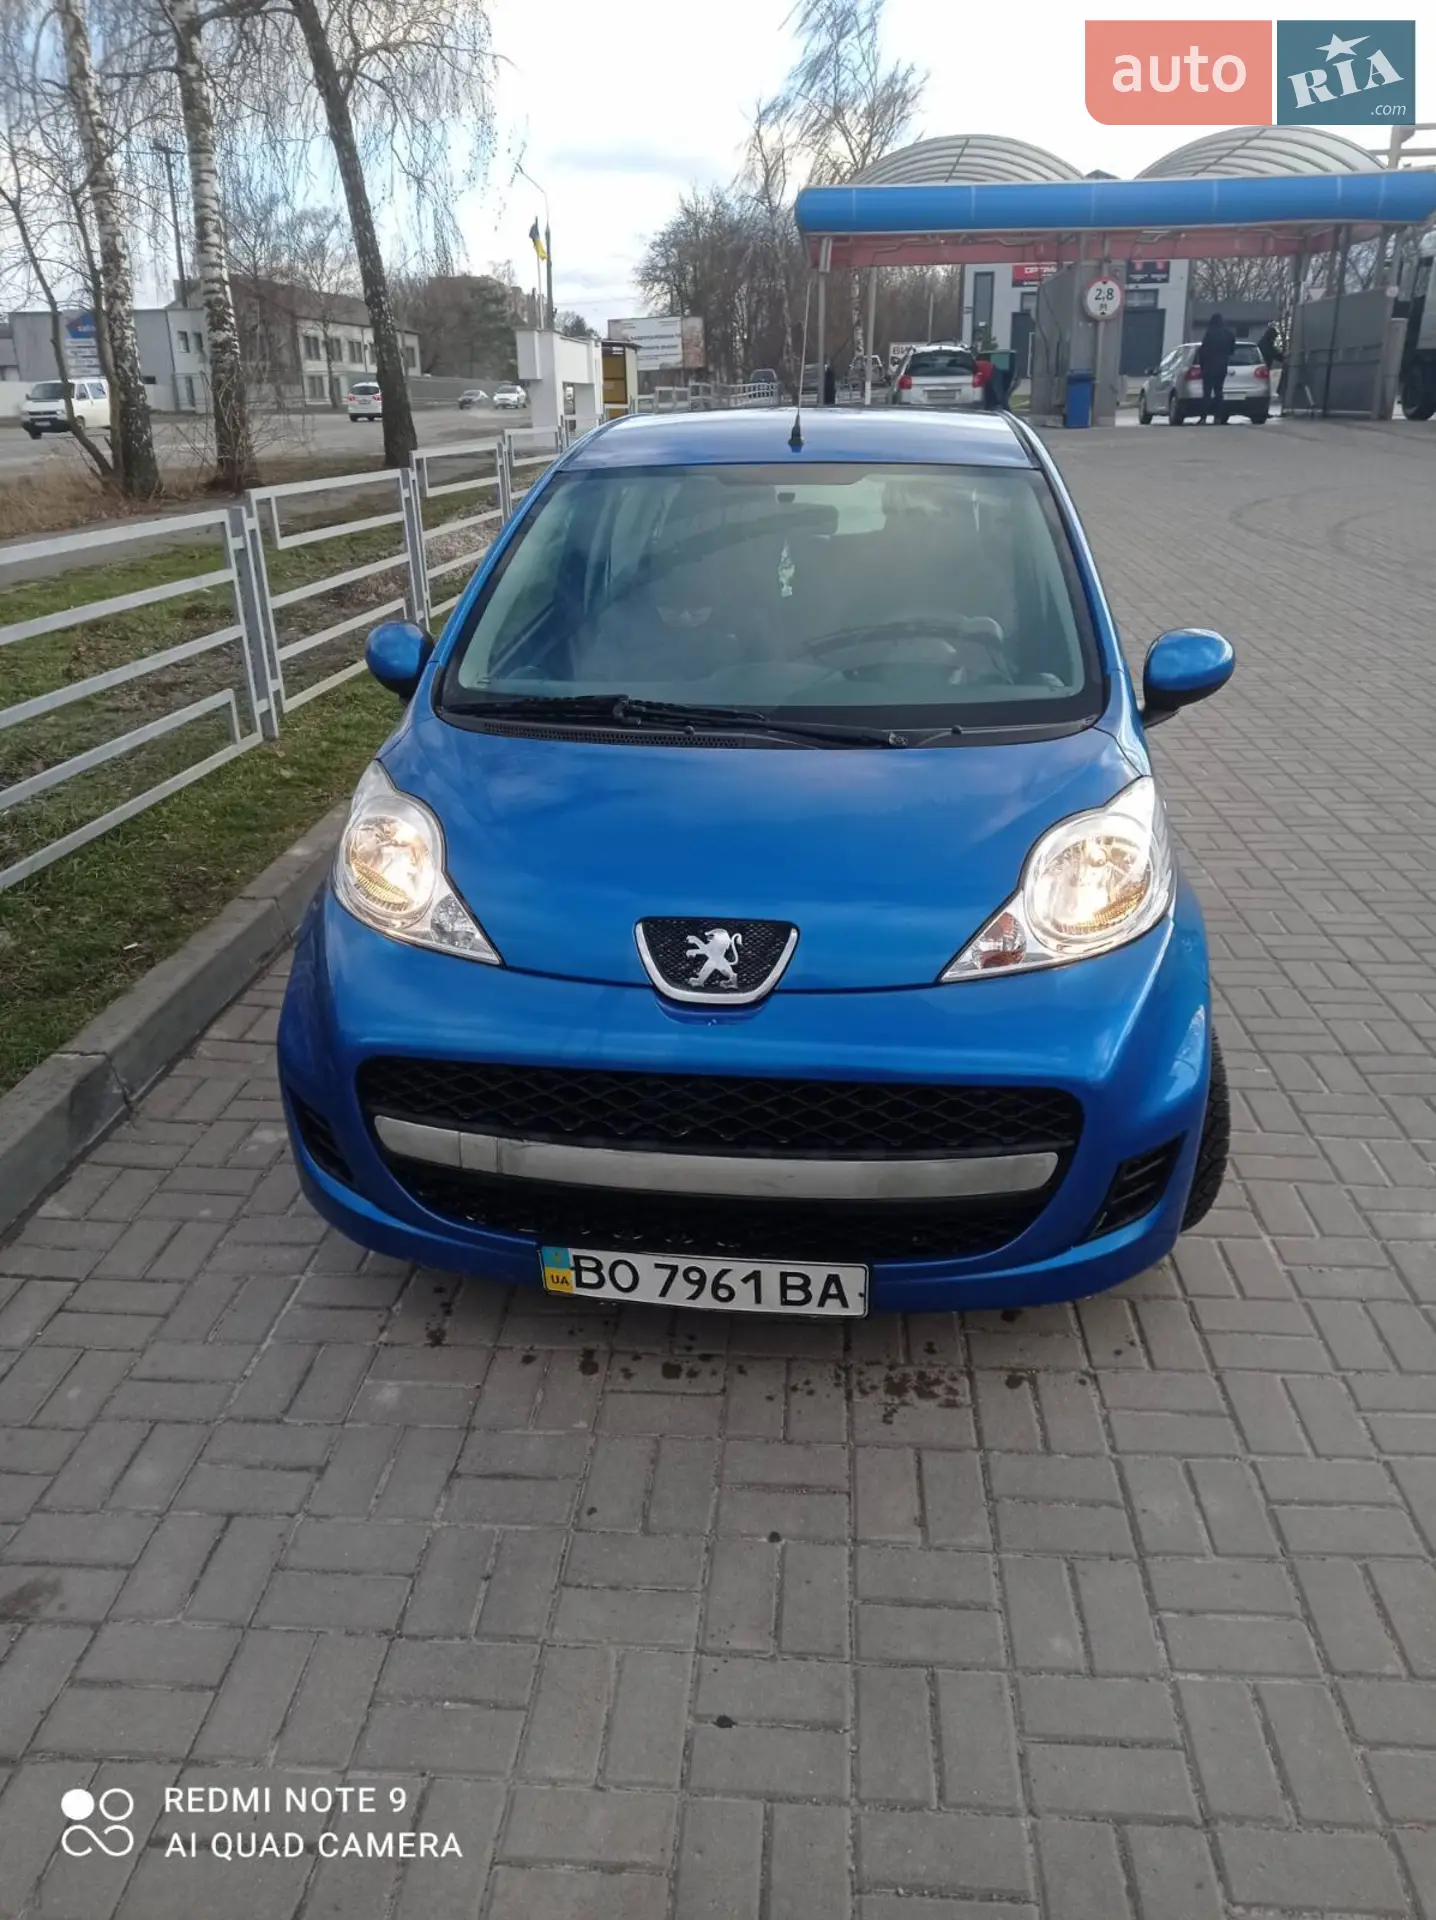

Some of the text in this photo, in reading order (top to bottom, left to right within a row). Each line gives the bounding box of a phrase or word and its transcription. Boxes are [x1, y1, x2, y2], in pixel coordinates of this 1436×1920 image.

[551, 1273, 570, 1286] UA
[572, 1254, 850, 1309] BO 7961 BA
